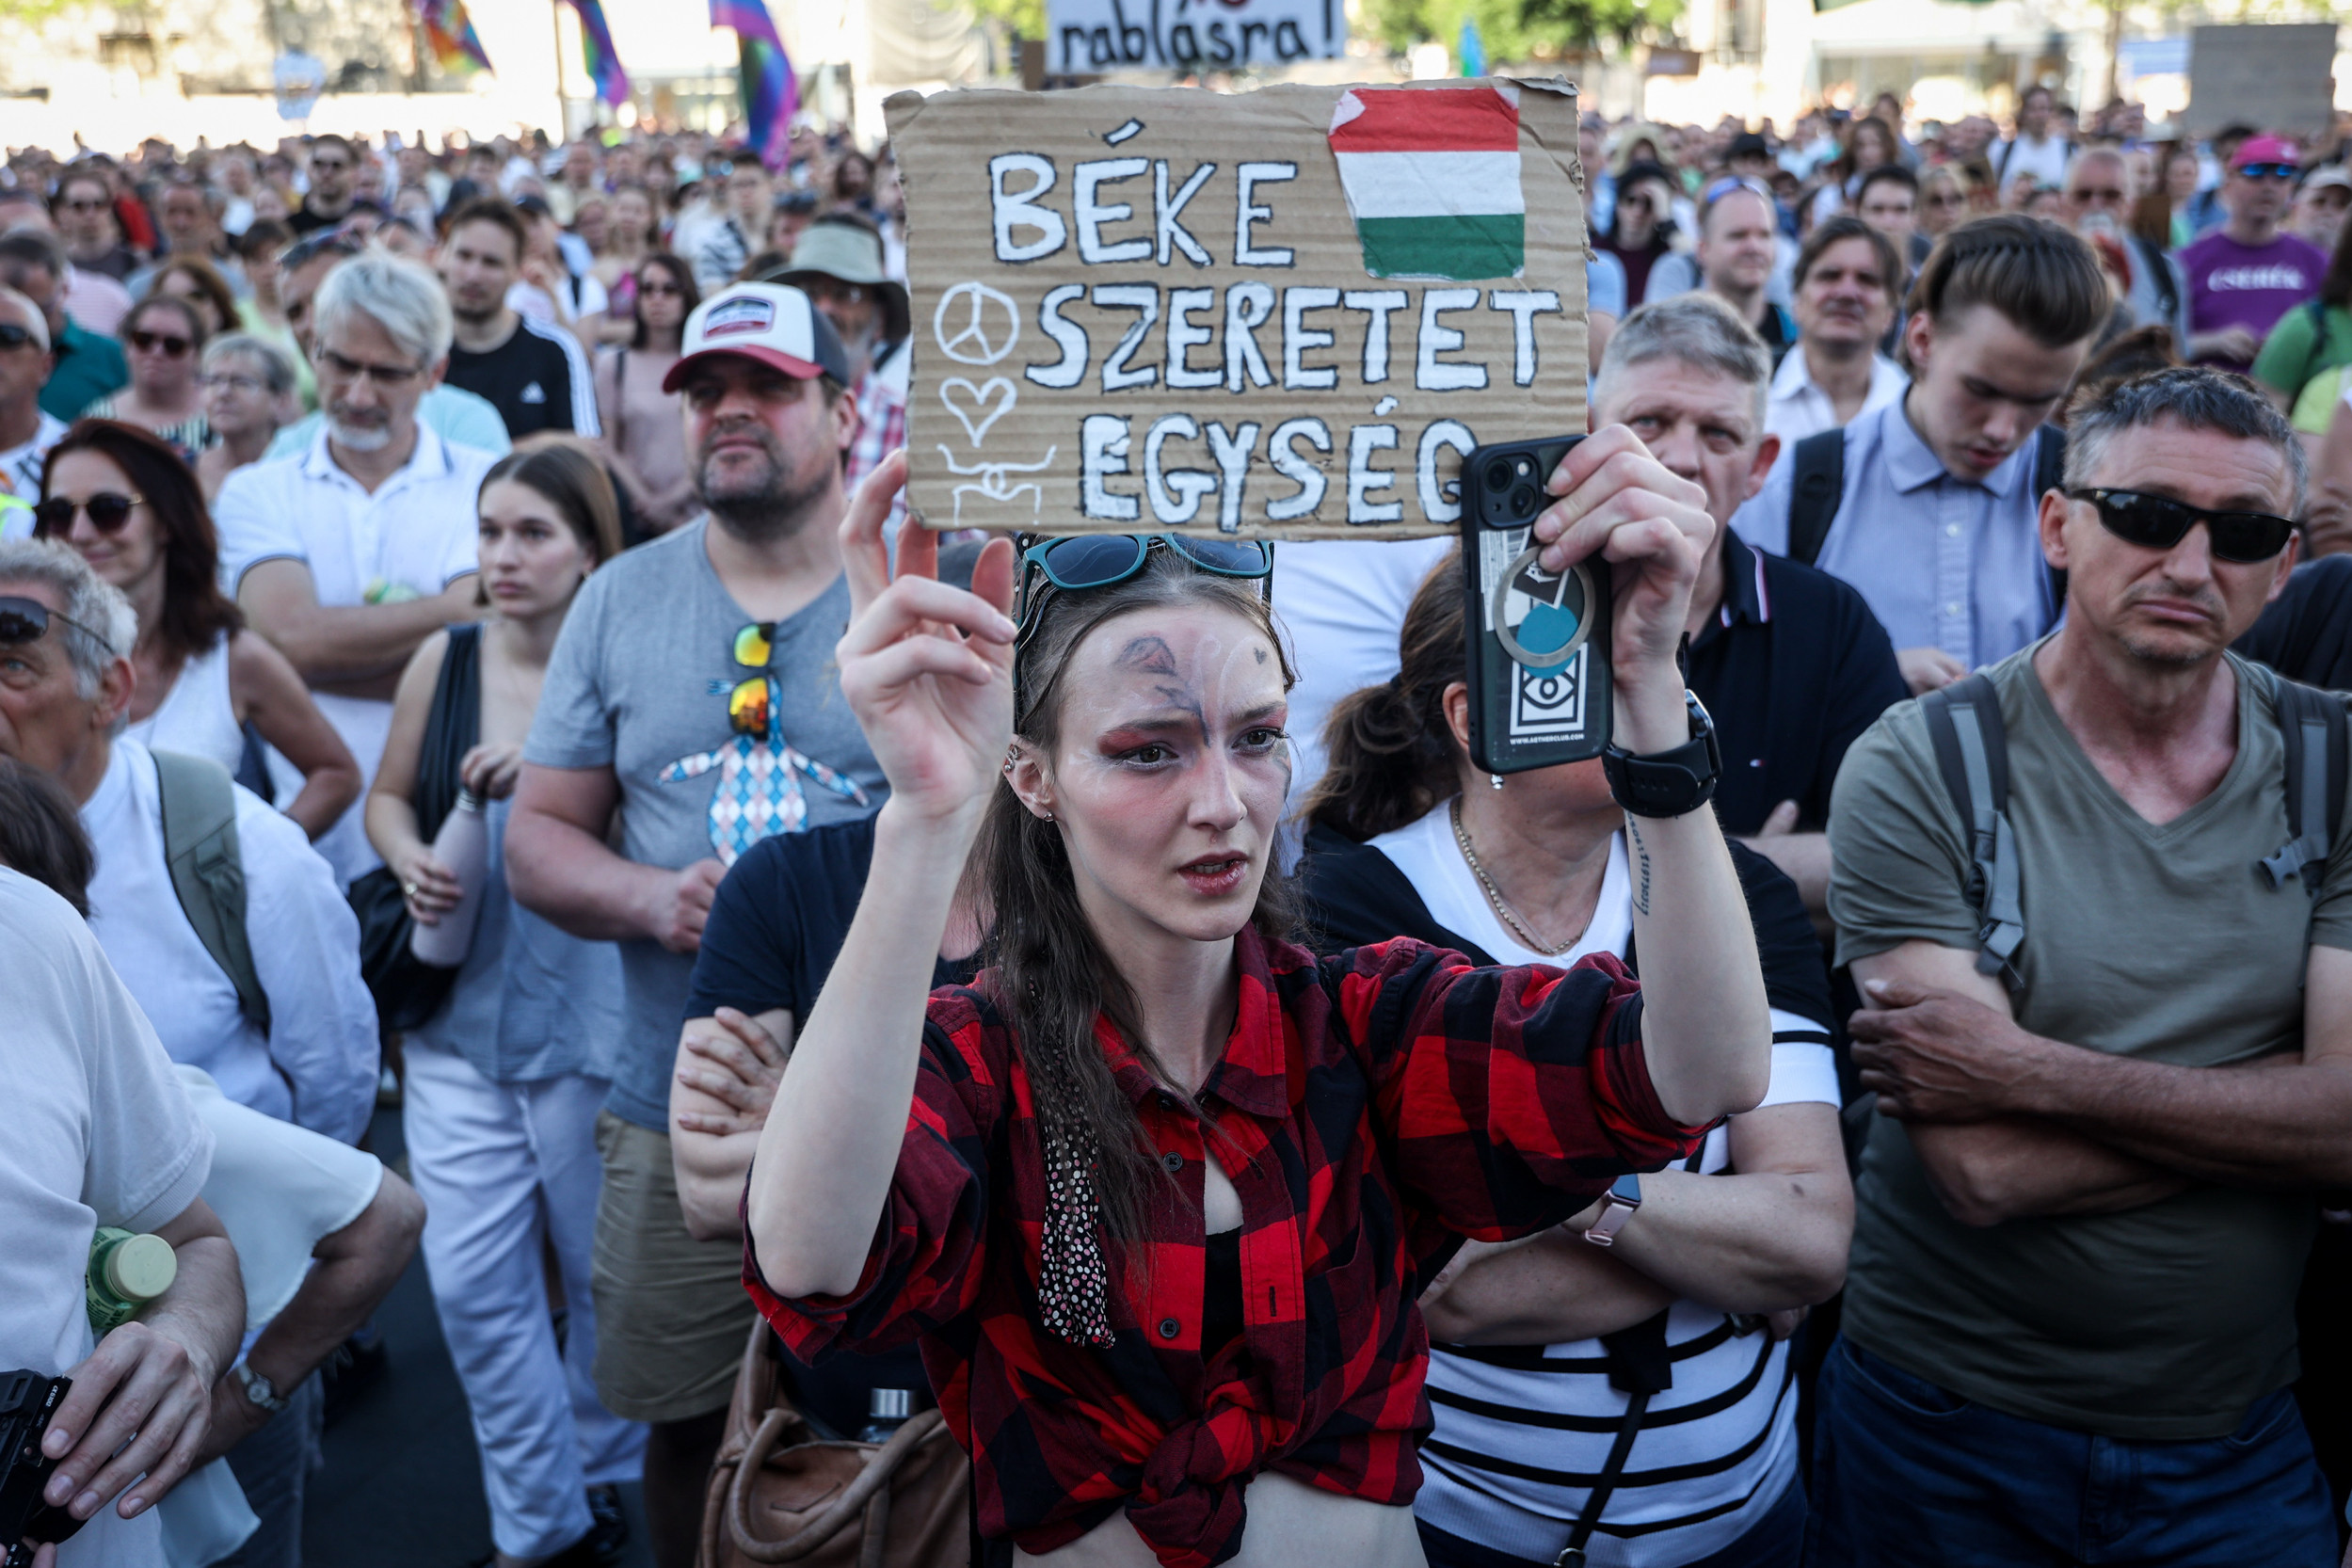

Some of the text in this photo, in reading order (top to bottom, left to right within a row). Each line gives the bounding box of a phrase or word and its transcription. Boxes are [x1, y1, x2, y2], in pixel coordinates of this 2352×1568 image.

[988, 118, 1298, 268] BÉKE
[1024, 280, 1563, 394] SZERETET
[1079, 395, 1478, 535] EGYSÉG
